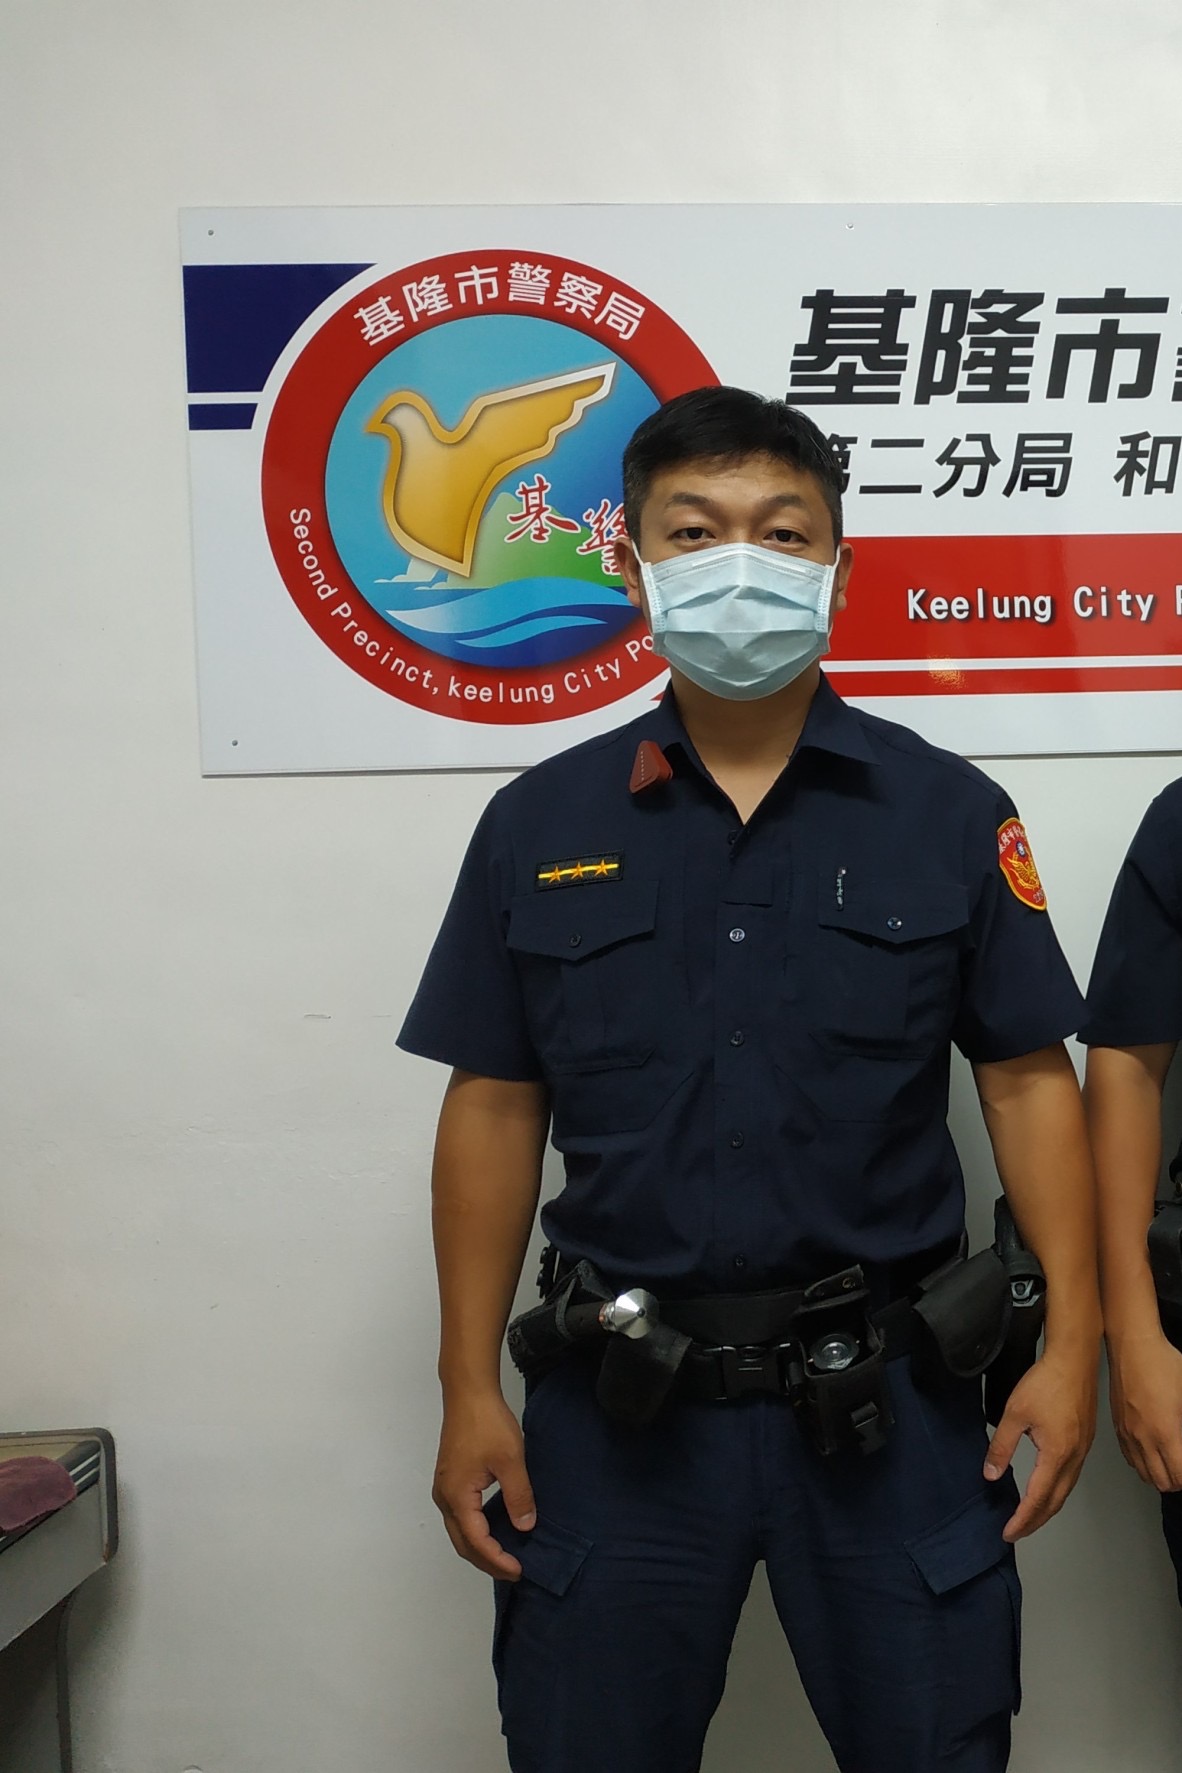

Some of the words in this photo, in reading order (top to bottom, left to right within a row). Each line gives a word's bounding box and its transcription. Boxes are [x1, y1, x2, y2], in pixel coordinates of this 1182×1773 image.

[353, 262, 646, 346] 基隆市警察局
[290, 508, 338, 601] Second
[331, 602, 439, 695] Precinct,
[448, 676, 554, 703] keelung
[563, 658, 621, 694] City
[907, 588, 1052, 623] Keelung
[1073, 585, 1154, 621] City
